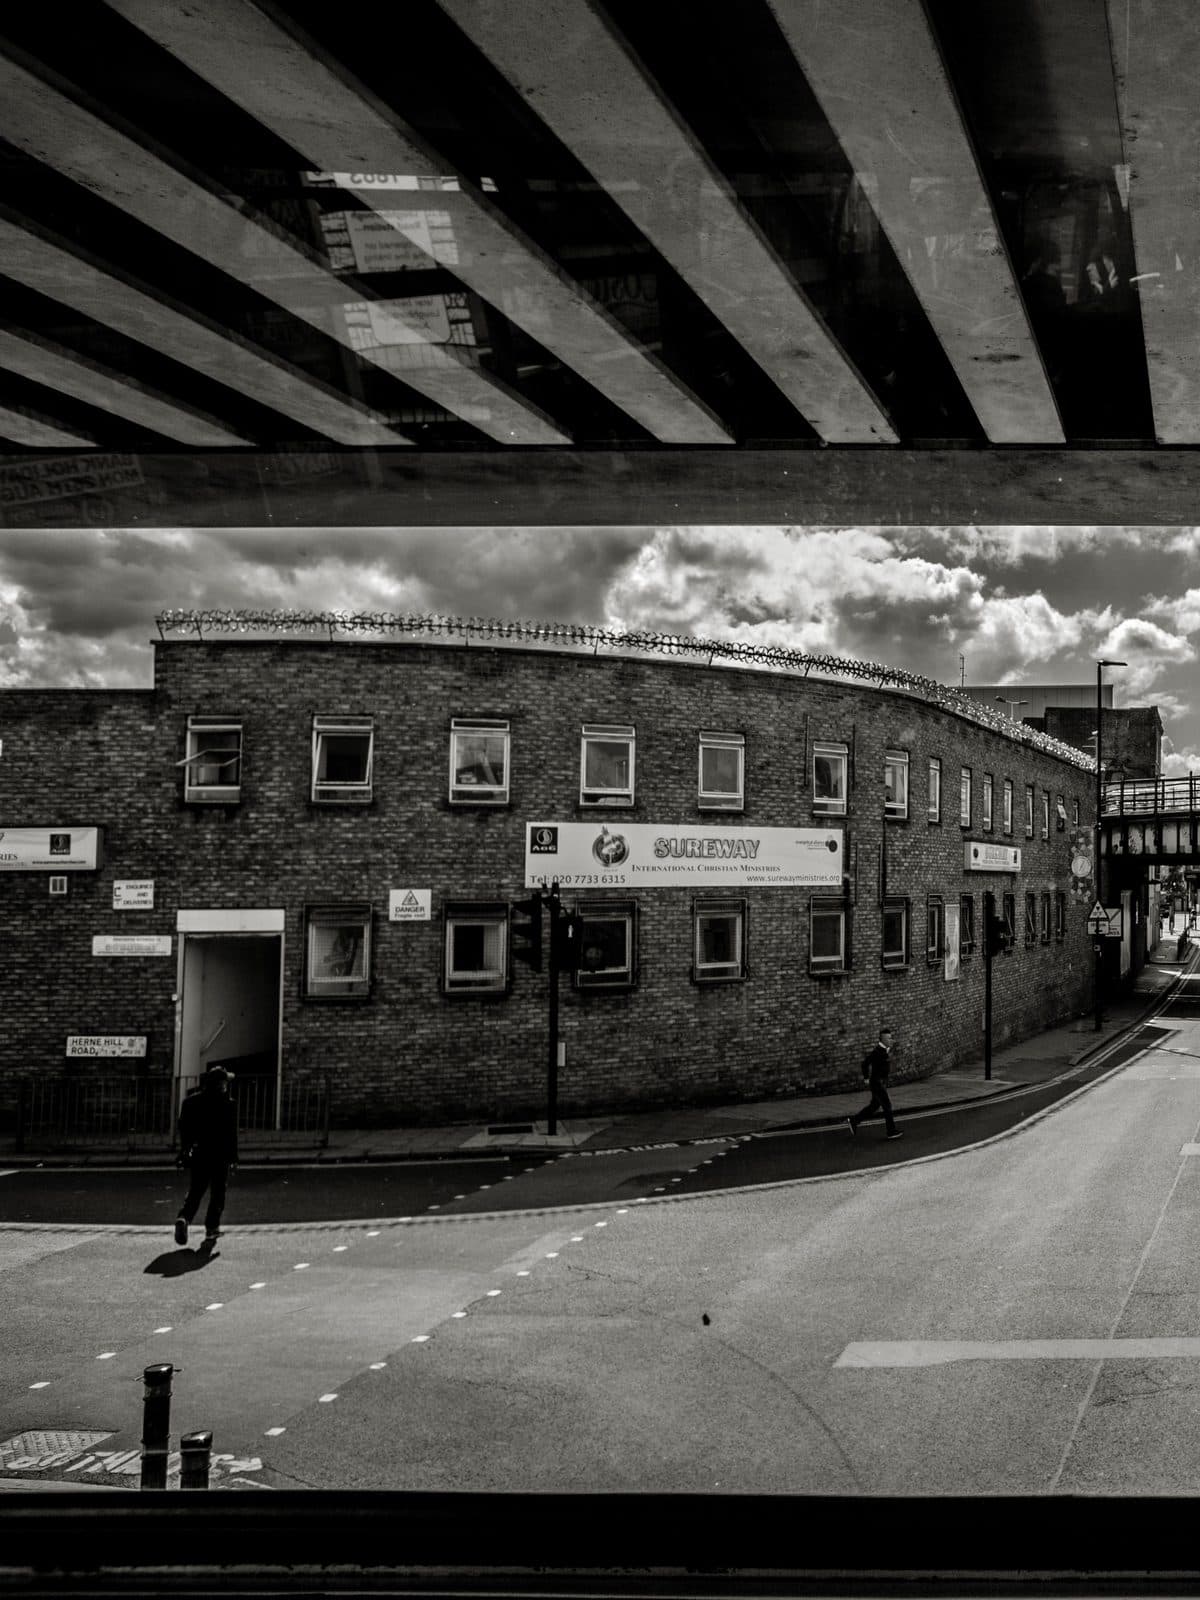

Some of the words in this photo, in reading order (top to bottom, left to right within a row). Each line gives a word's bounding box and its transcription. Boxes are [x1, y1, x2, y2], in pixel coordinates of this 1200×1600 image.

[655, 837, 760, 859] SUREWAY
[552, 874, 572, 884] 020
[574, 874, 599, 884] 7733
[601, 874, 626, 884] 6315
[71, 1038, 102, 1046] HERNE
[103, 1038, 124, 1046] HILL
